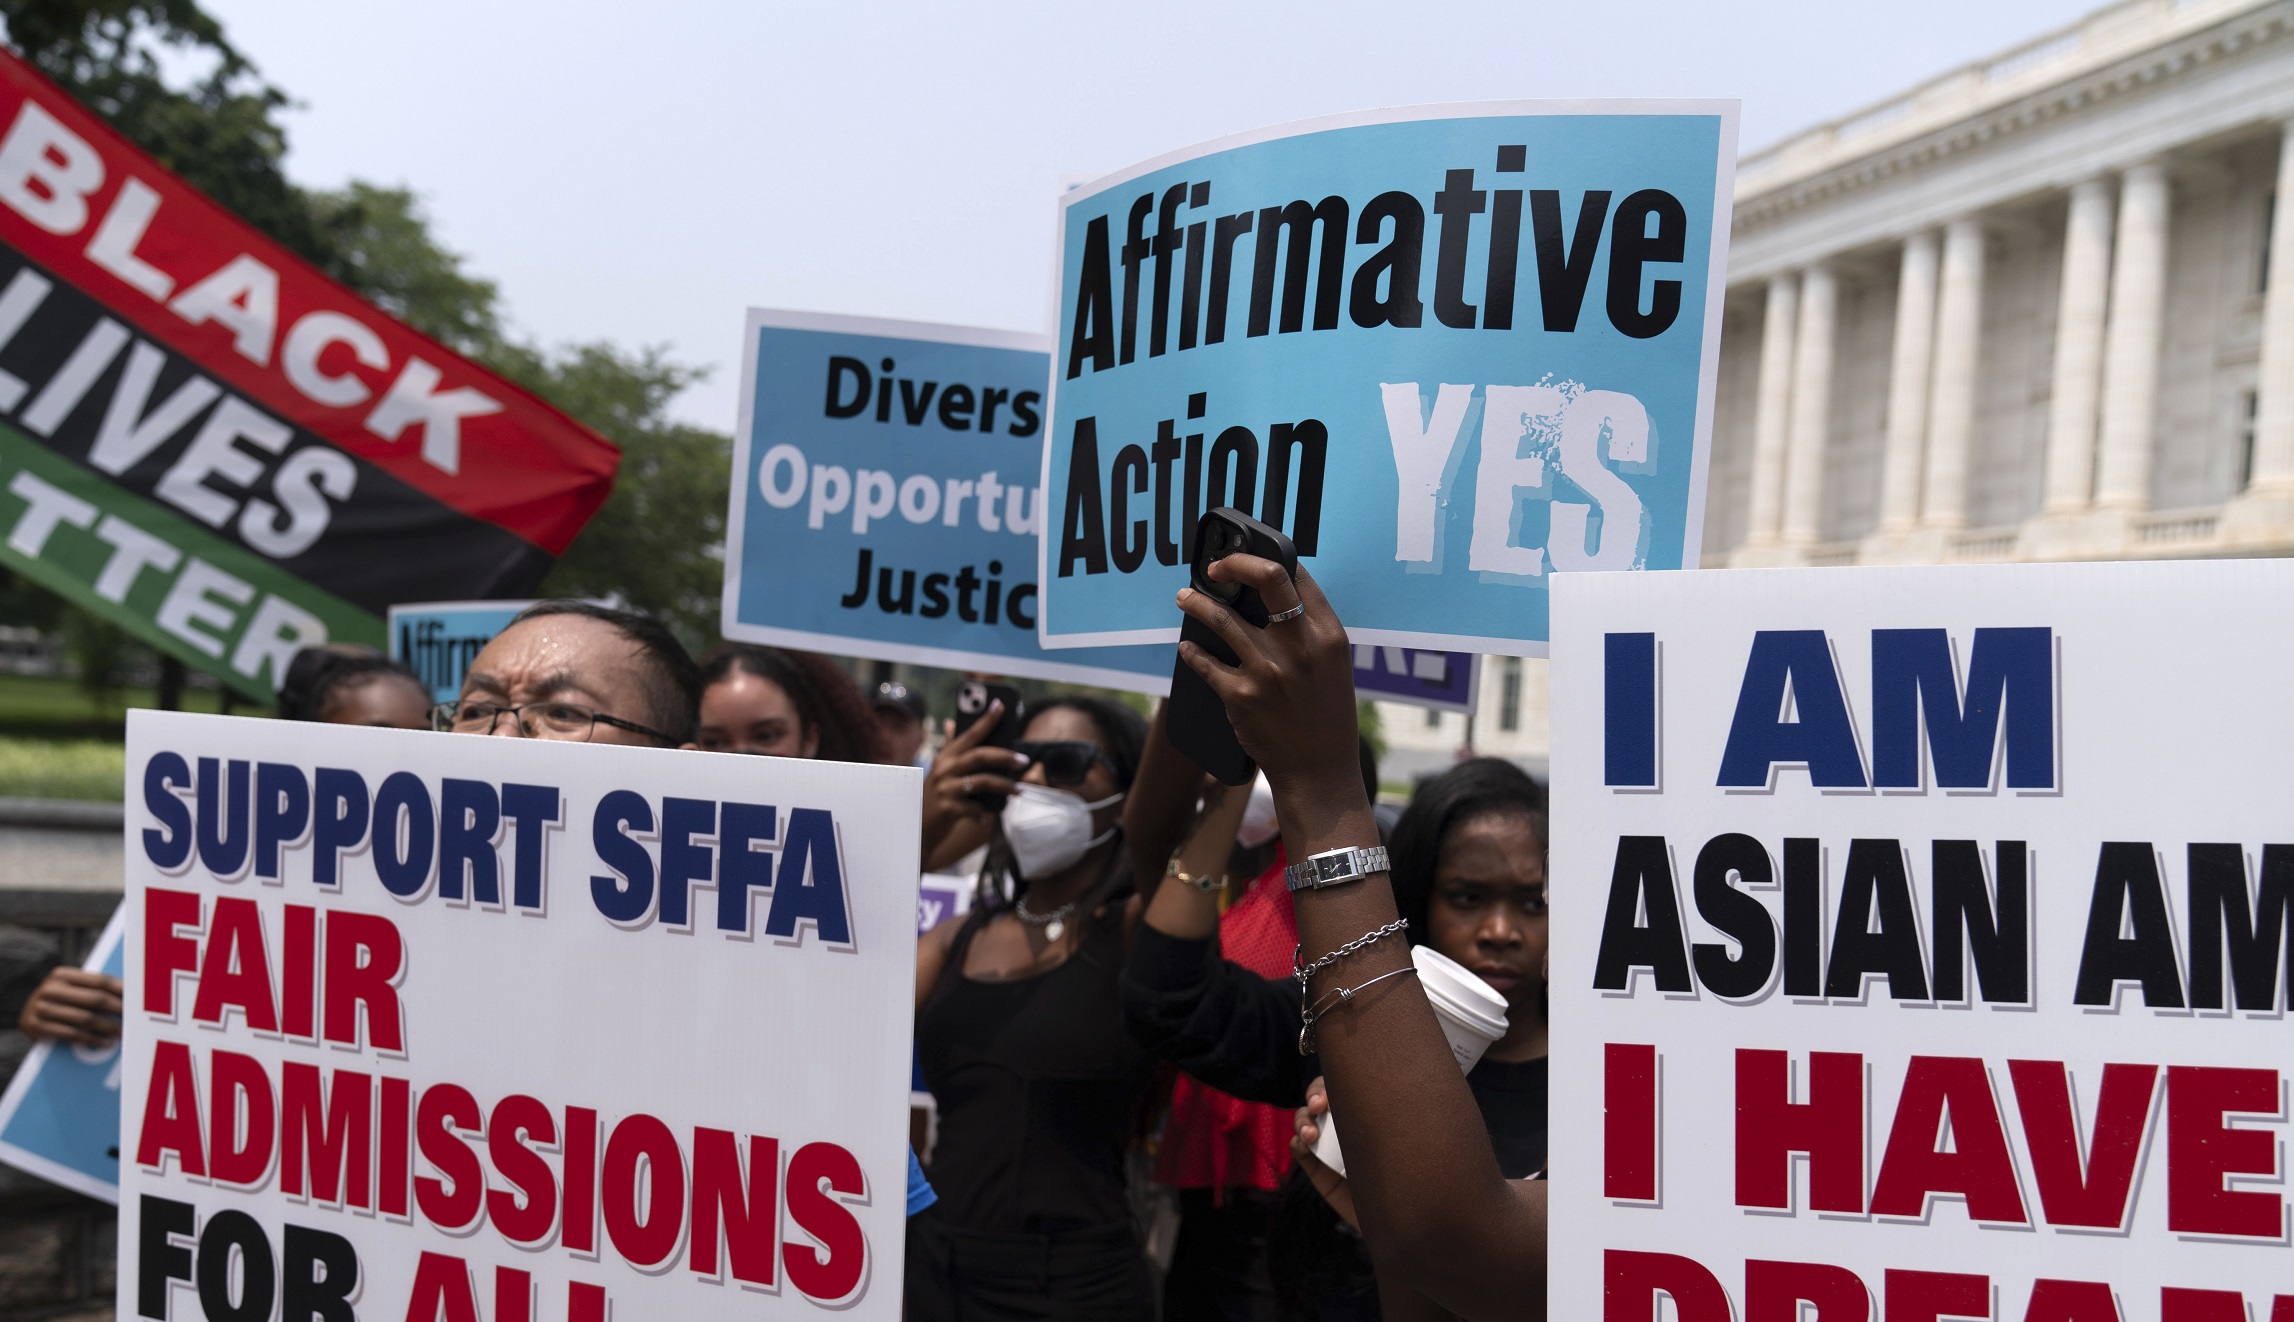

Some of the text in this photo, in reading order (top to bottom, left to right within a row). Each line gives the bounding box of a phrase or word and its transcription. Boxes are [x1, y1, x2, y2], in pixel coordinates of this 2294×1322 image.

[0, 99, 505, 477] BLACK
[1067, 144, 1686, 381] Affirmative
[824, 356, 1041, 438] Divers
[1058, 373, 1652, 577] Action YES
[758, 444, 1040, 536] Opportu
[841, 548, 1039, 630] Justic
[1604, 626, 2054, 788] I AM
[143, 751, 850, 944] SUPPORT SFFA
[1593, 833, 2028, 1003] ASIAN
[143, 887, 402, 1051] FAIR
[136, 1040, 865, 1300] ADMISSIONS
[1604, 1043, 2283, 1238] I HAVE
[138, 1193, 358, 1322] FOR
